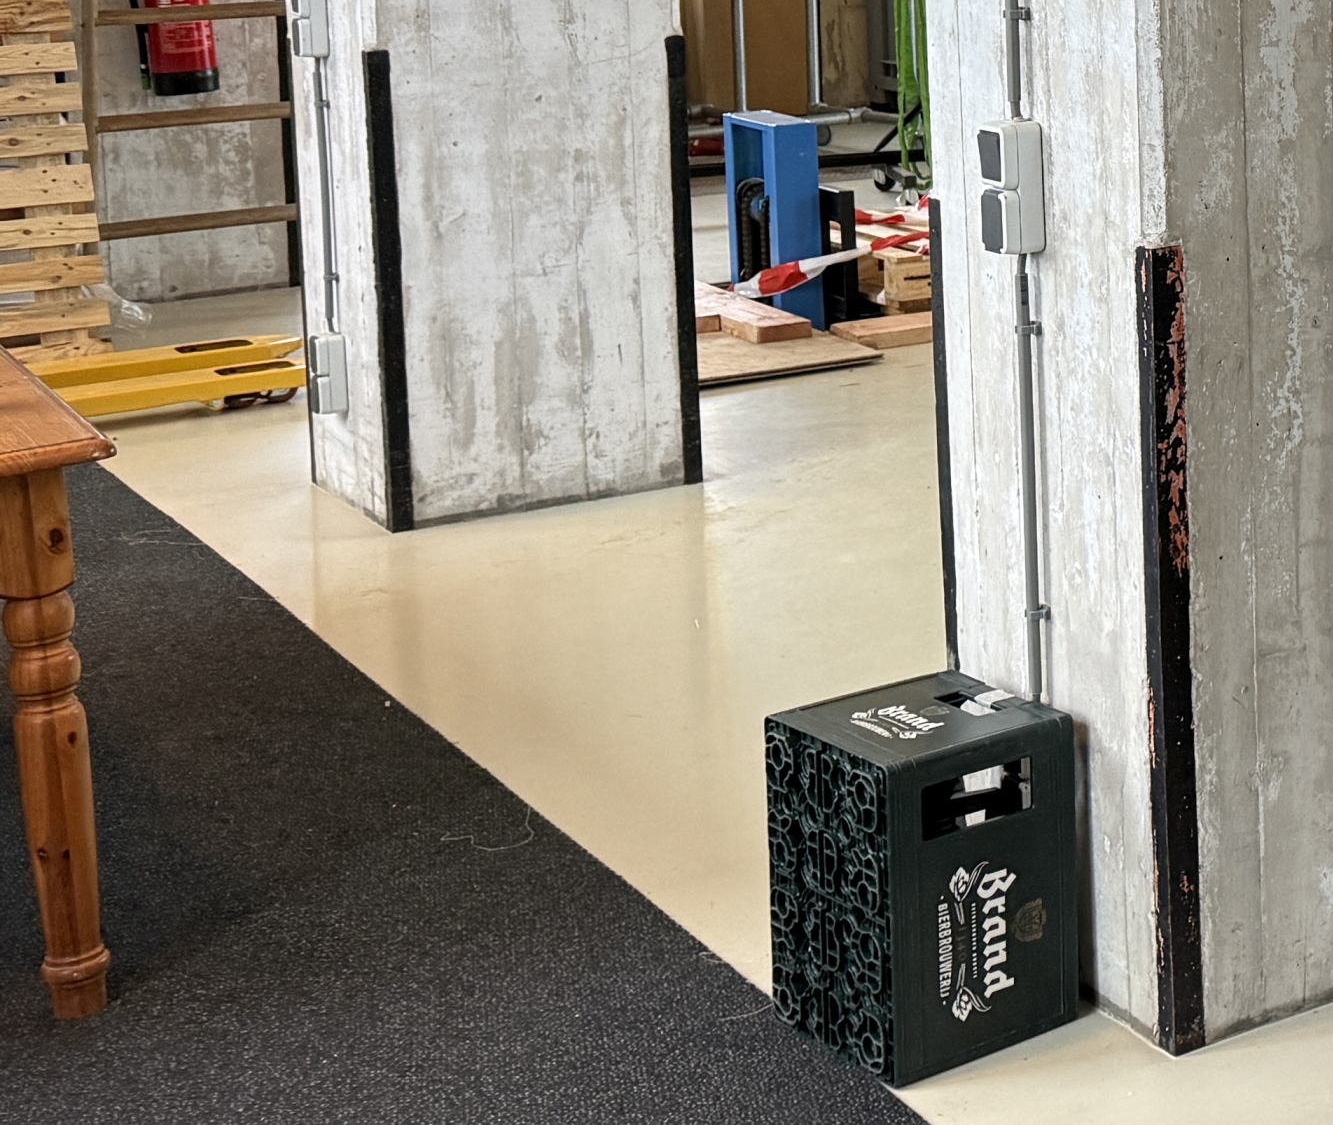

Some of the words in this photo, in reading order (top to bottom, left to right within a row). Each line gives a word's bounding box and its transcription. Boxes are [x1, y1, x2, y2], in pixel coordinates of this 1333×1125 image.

[877, 704, 945, 732] Brand
[937, 902, 953, 999] BIERBROUWERIJ
[976, 867, 1017, 999] Brand
